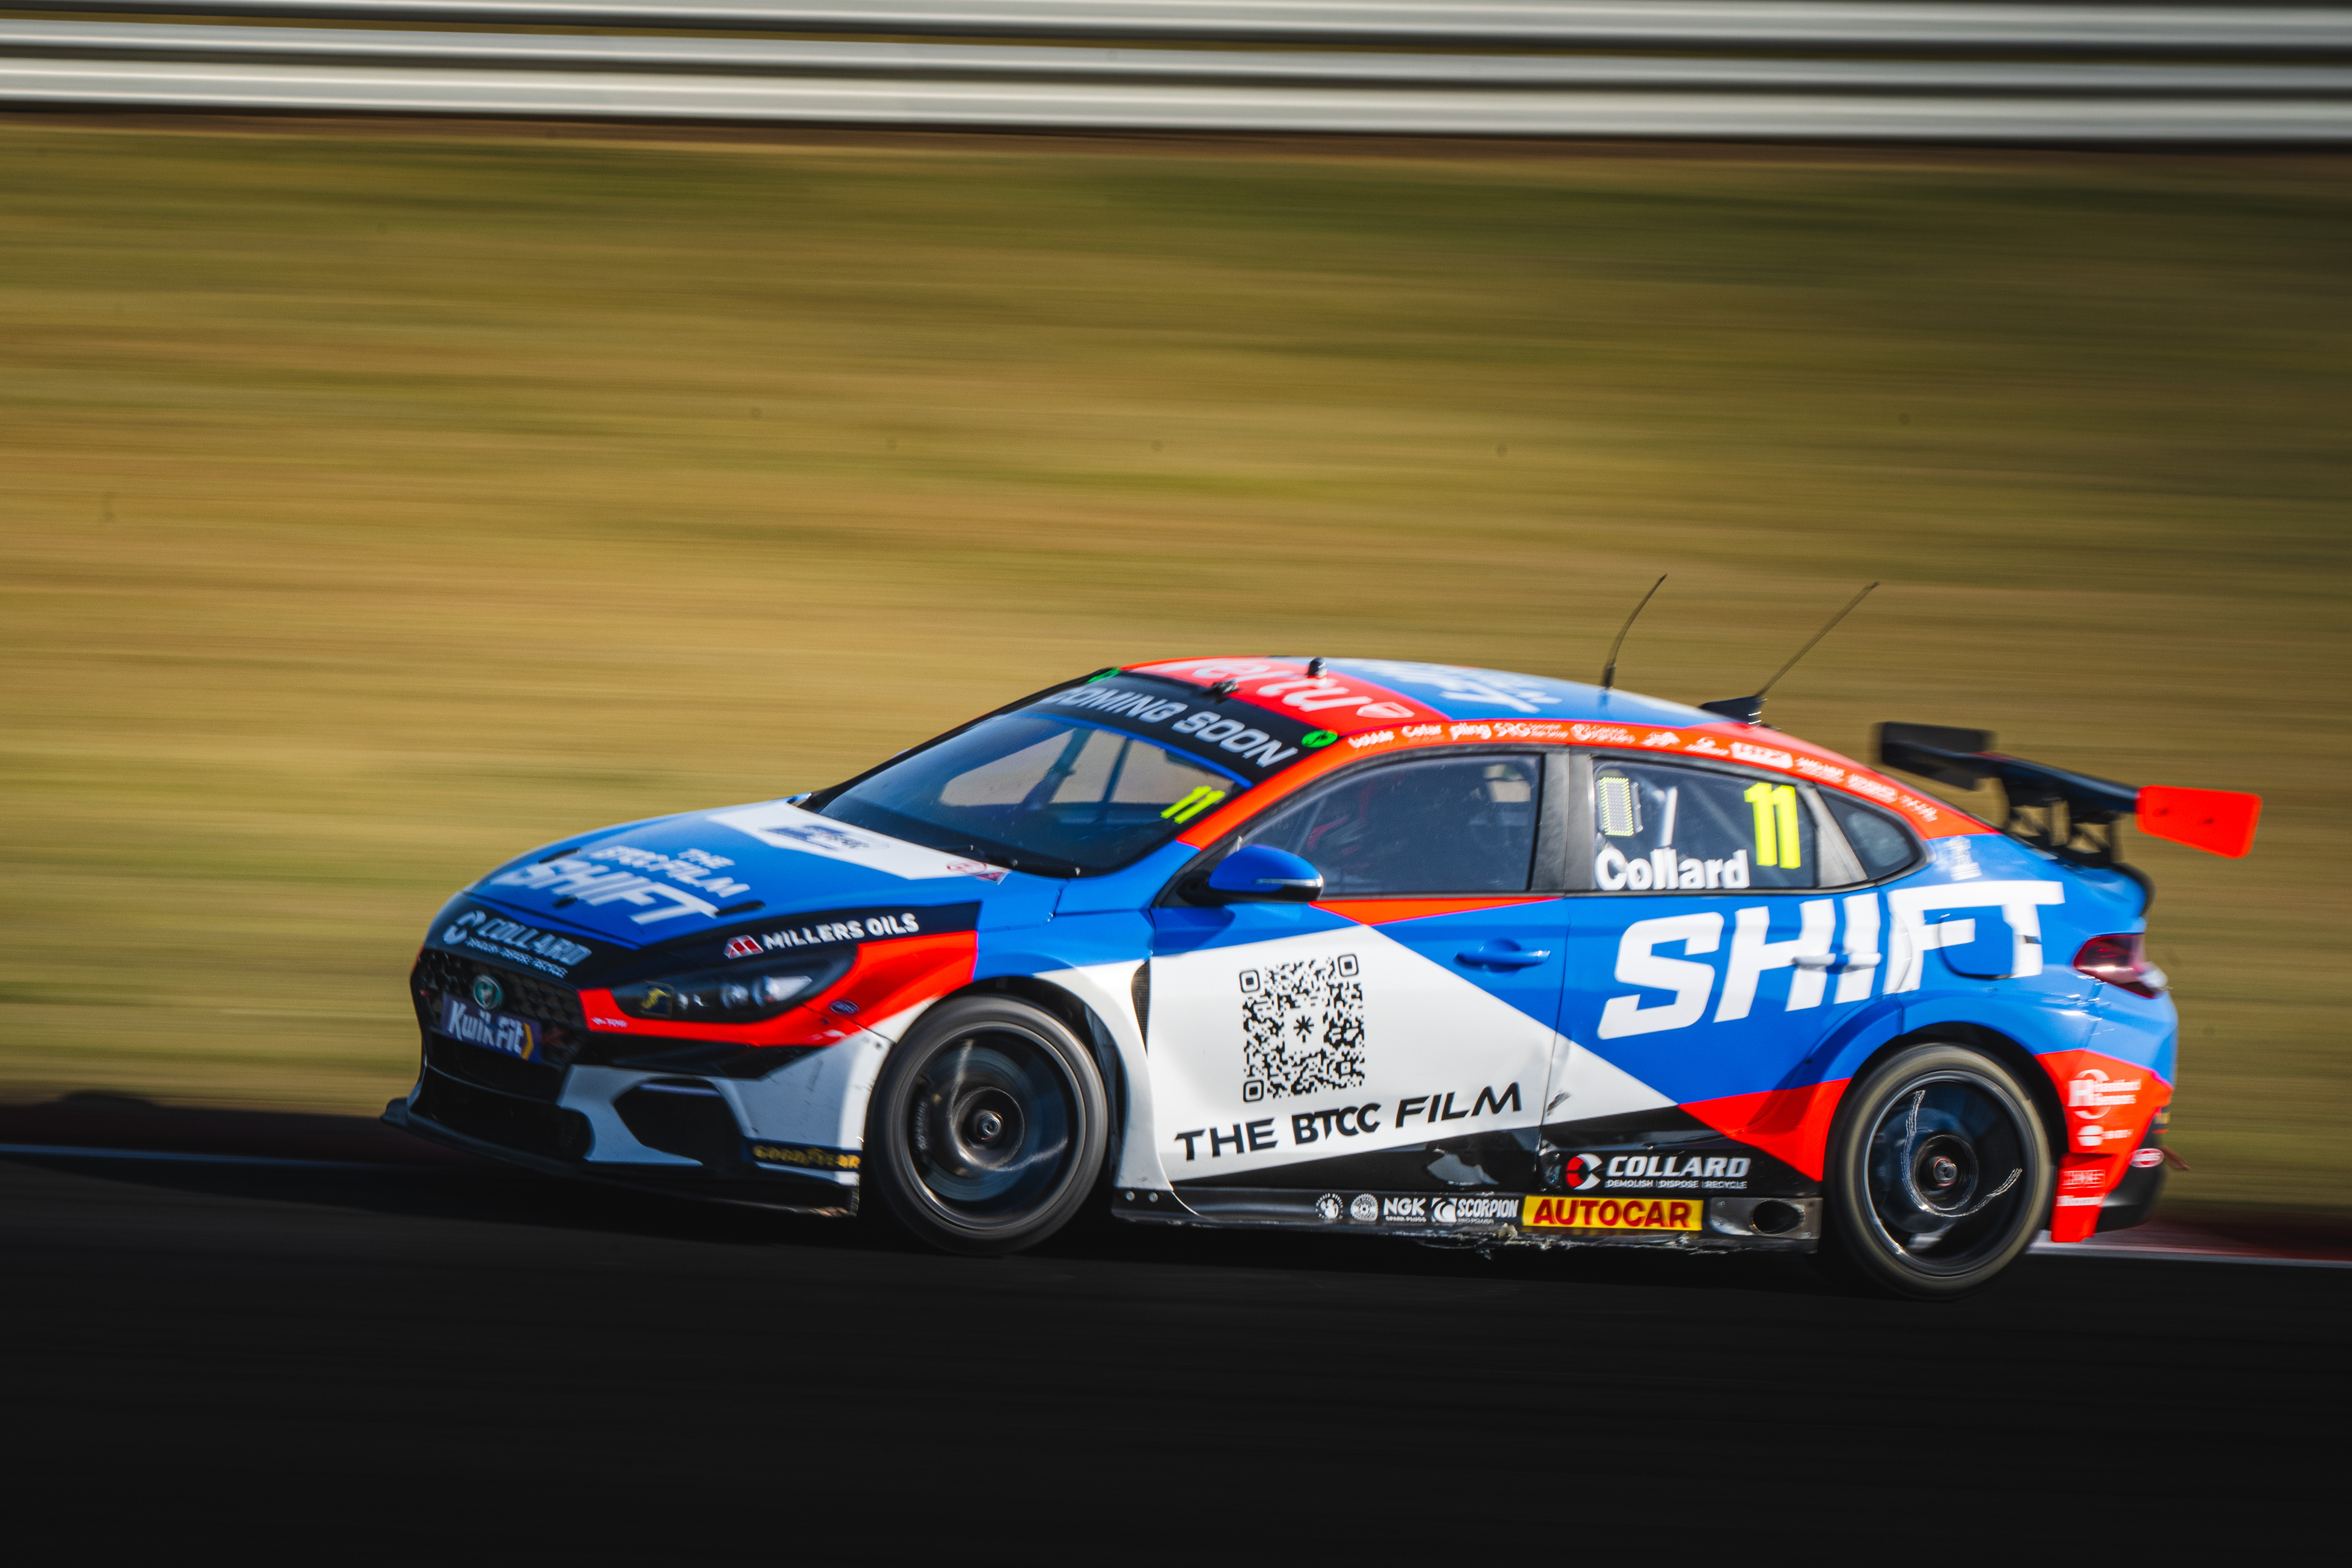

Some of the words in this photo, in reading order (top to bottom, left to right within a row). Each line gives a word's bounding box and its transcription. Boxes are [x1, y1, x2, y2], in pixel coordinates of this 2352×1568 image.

[1172, 710, 1298, 769] SOON
[1161, 785, 1226, 824] 11
[1744, 782, 1801, 869] 11
[1594, 848, 1751, 891] Collard
[475, 918, 592, 966] COLLARD
[762, 920, 865, 950] MILLERS
[865, 913, 919, 937] OILS
[1597, 881, 2066, 1040] SHIFT
[1174, 1117, 1278, 1161] THE
[1291, 1102, 1382, 1145] BTCC
[1395, 1082, 1522, 1128] FILM
[1605, 1180, 1654, 1188] DEMOLISH
[1657, 1180, 1699, 1189] DISPOSE
[1704, 1181, 1747, 1189] RECYCLE
[1606, 1156, 1751, 1177] COLLARD
[1383, 1197, 1427, 1216] NGK
[1457, 1198, 1519, 1218] SCORPION
[1532, 1198, 1692, 1228] AUTOCAR
